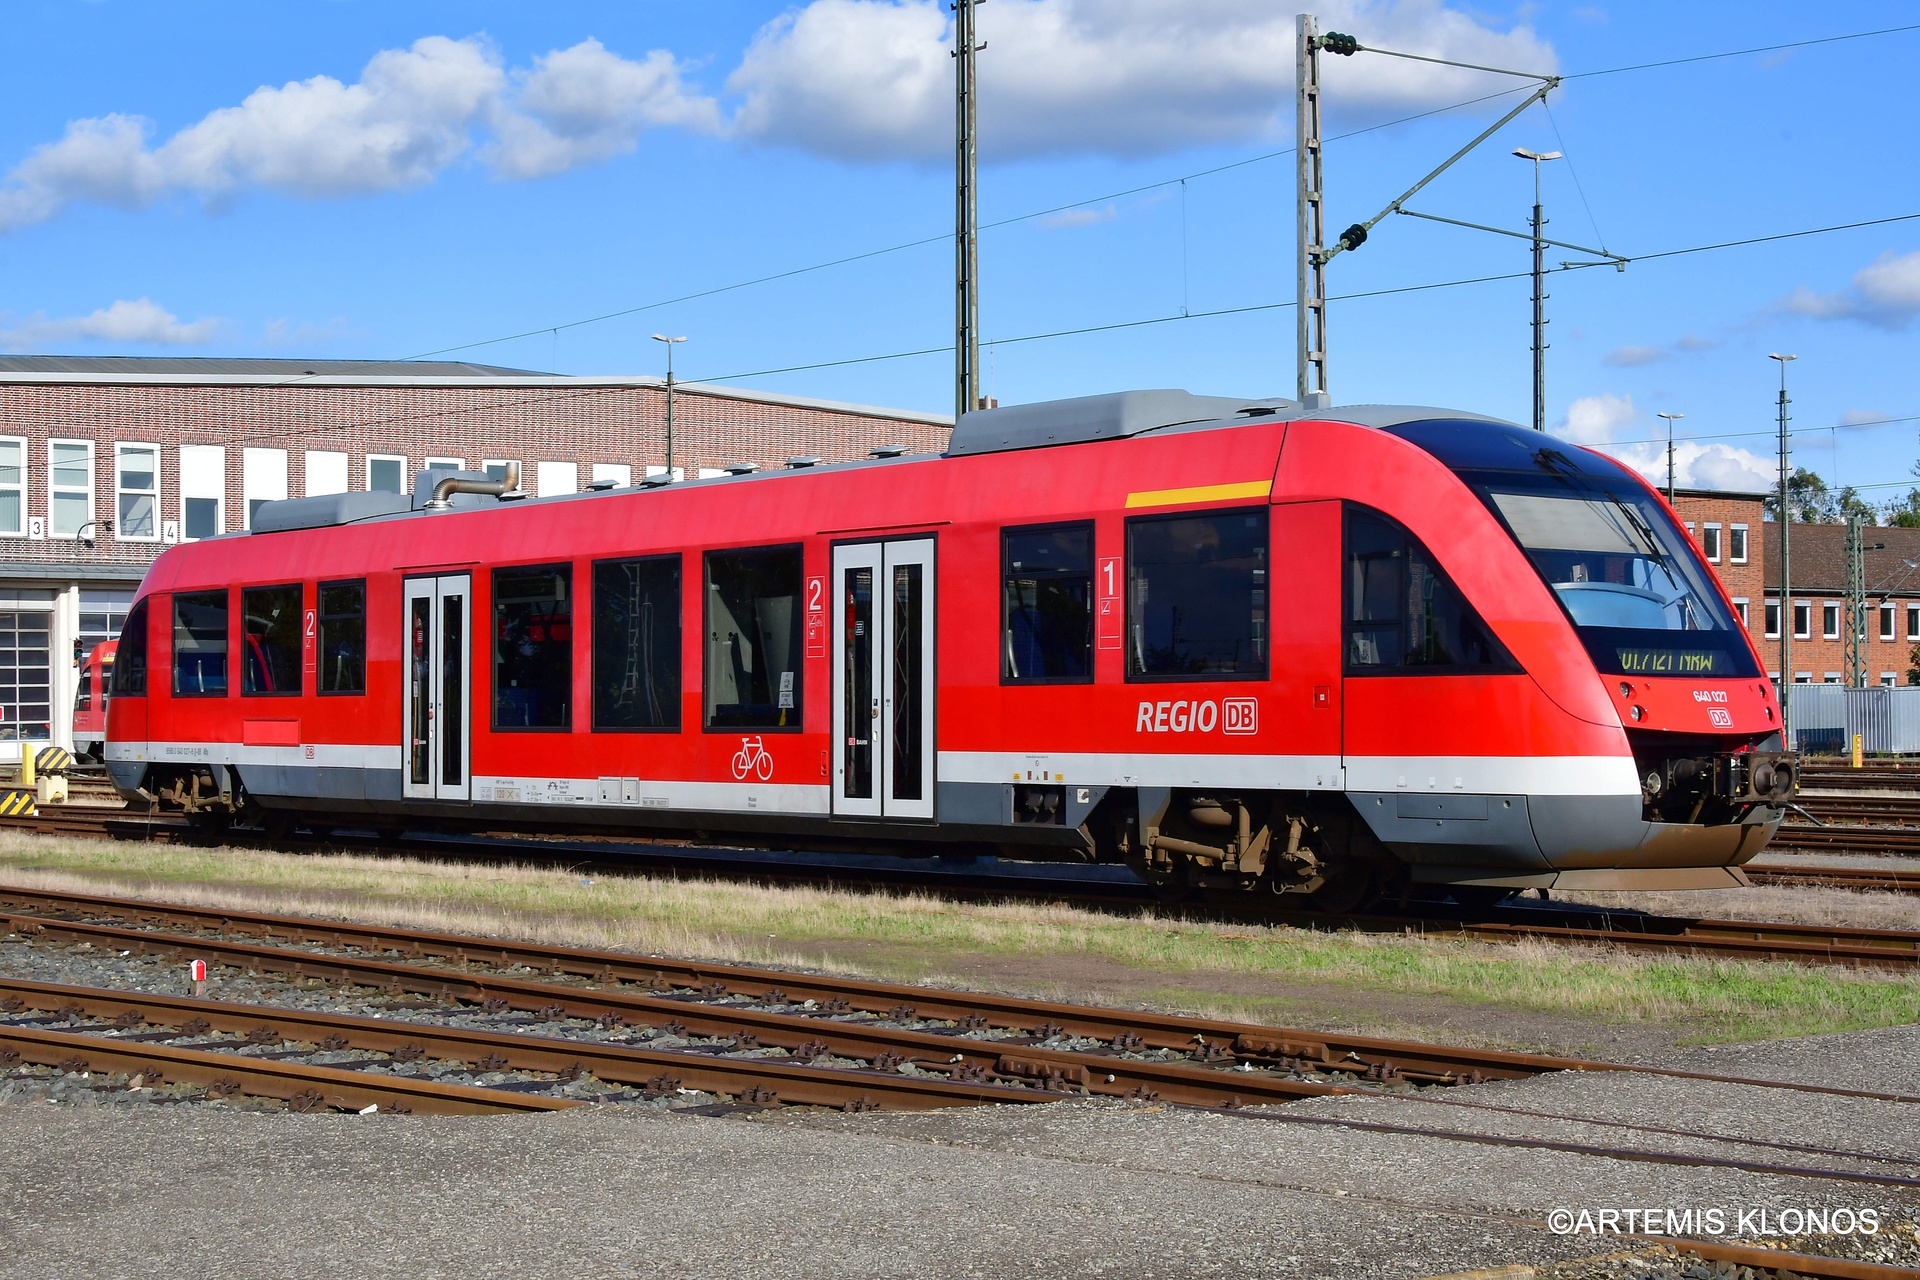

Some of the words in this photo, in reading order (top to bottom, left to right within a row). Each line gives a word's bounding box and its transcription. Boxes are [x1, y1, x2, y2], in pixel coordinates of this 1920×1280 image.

[32, 521, 41, 535] 3
[167, 525, 174, 539] 4
[1103, 561, 1114, 596] 1
[808, 579, 822, 611] 2
[306, 611, 315, 636] 2
[1692, 690, 1712, 703] 640
[1713, 691, 1728, 703] 027
[1136, 700, 1218, 733] REGIO
[1224, 699, 1257, 733] DB
[1709, 708, 1732, 727] DB
